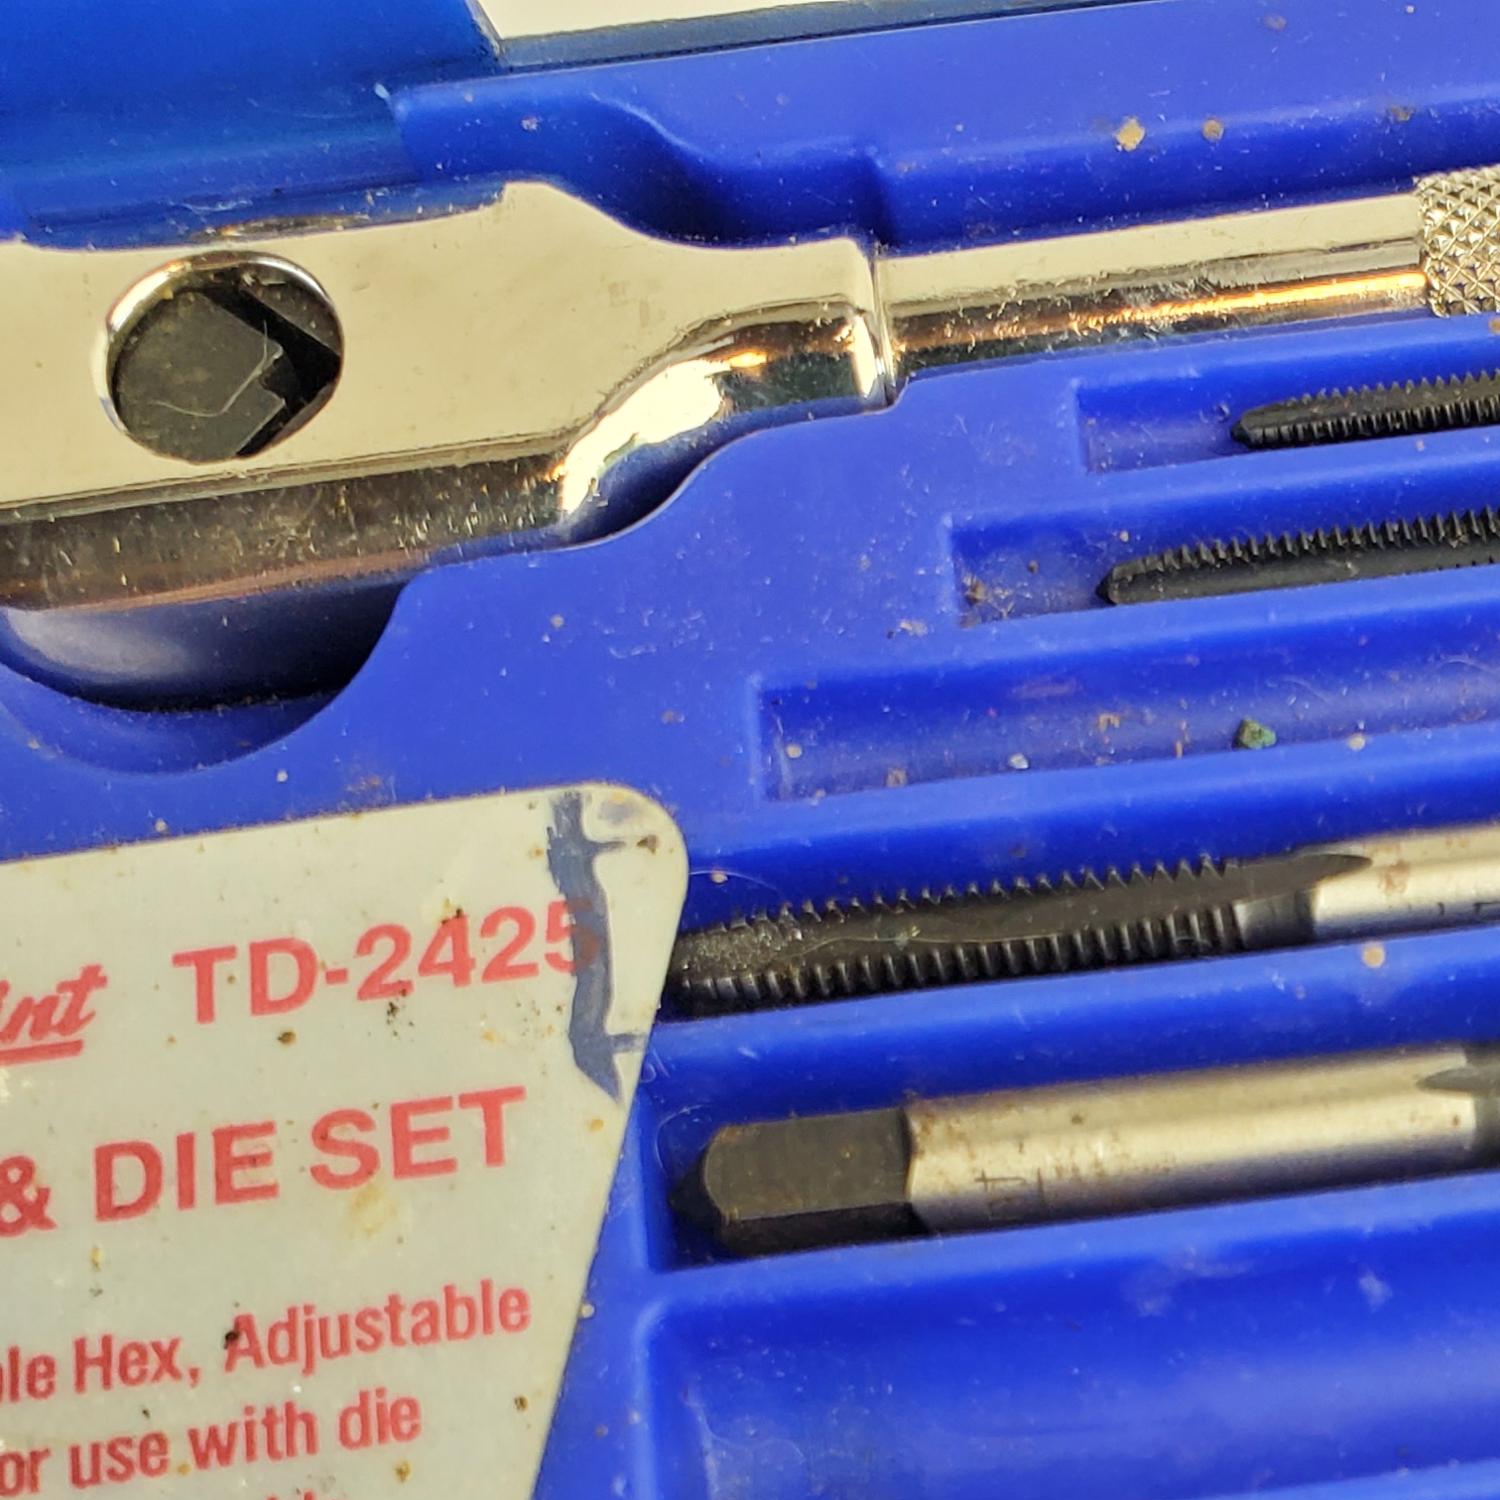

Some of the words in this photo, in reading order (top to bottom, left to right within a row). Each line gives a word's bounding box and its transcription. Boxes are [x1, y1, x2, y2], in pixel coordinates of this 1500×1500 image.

[171, 899, 597, 1024] TD-2425
[0, 1155, 57, 1238] &
[93, 1120, 280, 1222] DIE
[309, 1085, 526, 1190] SET
[0, 1346, 57, 1403] le
[73, 1333, 201, 1393] Hex,
[222, 1279, 531, 1376] Adjustable
[68, 1431, 170, 1489] use
[187, 1400, 319, 1470] with
[337, 1388, 422, 1451] die
